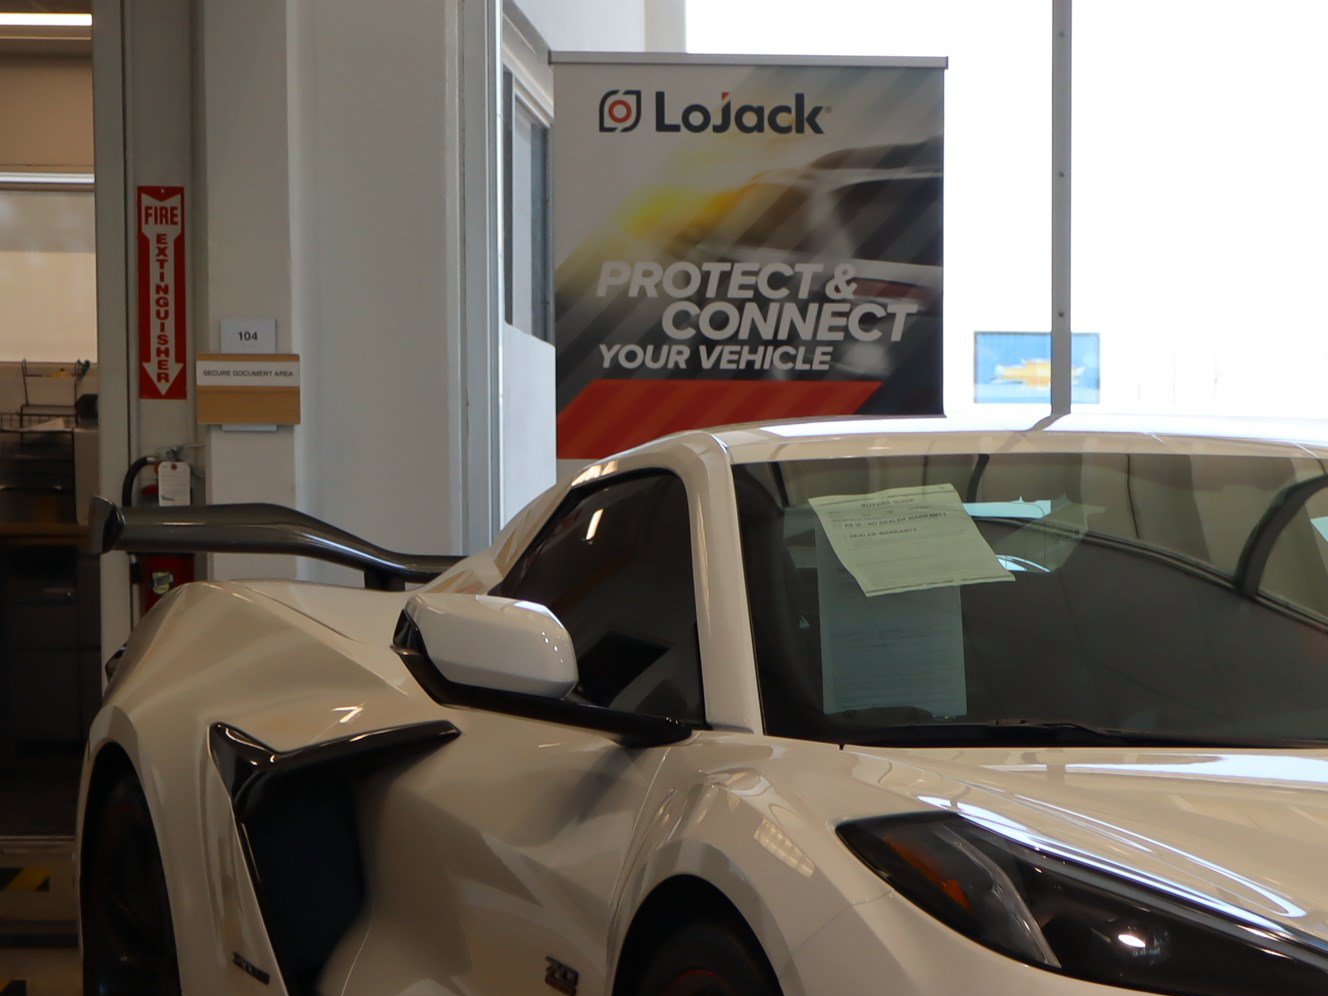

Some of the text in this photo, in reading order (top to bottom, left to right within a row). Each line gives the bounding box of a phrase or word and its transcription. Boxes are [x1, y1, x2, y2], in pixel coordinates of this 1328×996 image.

[144, 205, 179, 226] FIRE
[596, 261, 858, 300] PROTECT &
[155, 233, 170, 383] EXTINGUISHER
[662, 301, 918, 342] CONNECT
[238, 331, 258, 341] 104
[599, 344, 833, 370] YOUR VEHICLE
[203, 369, 231, 377] SECURE
[907, 511, 947, 521] WARRANTY
